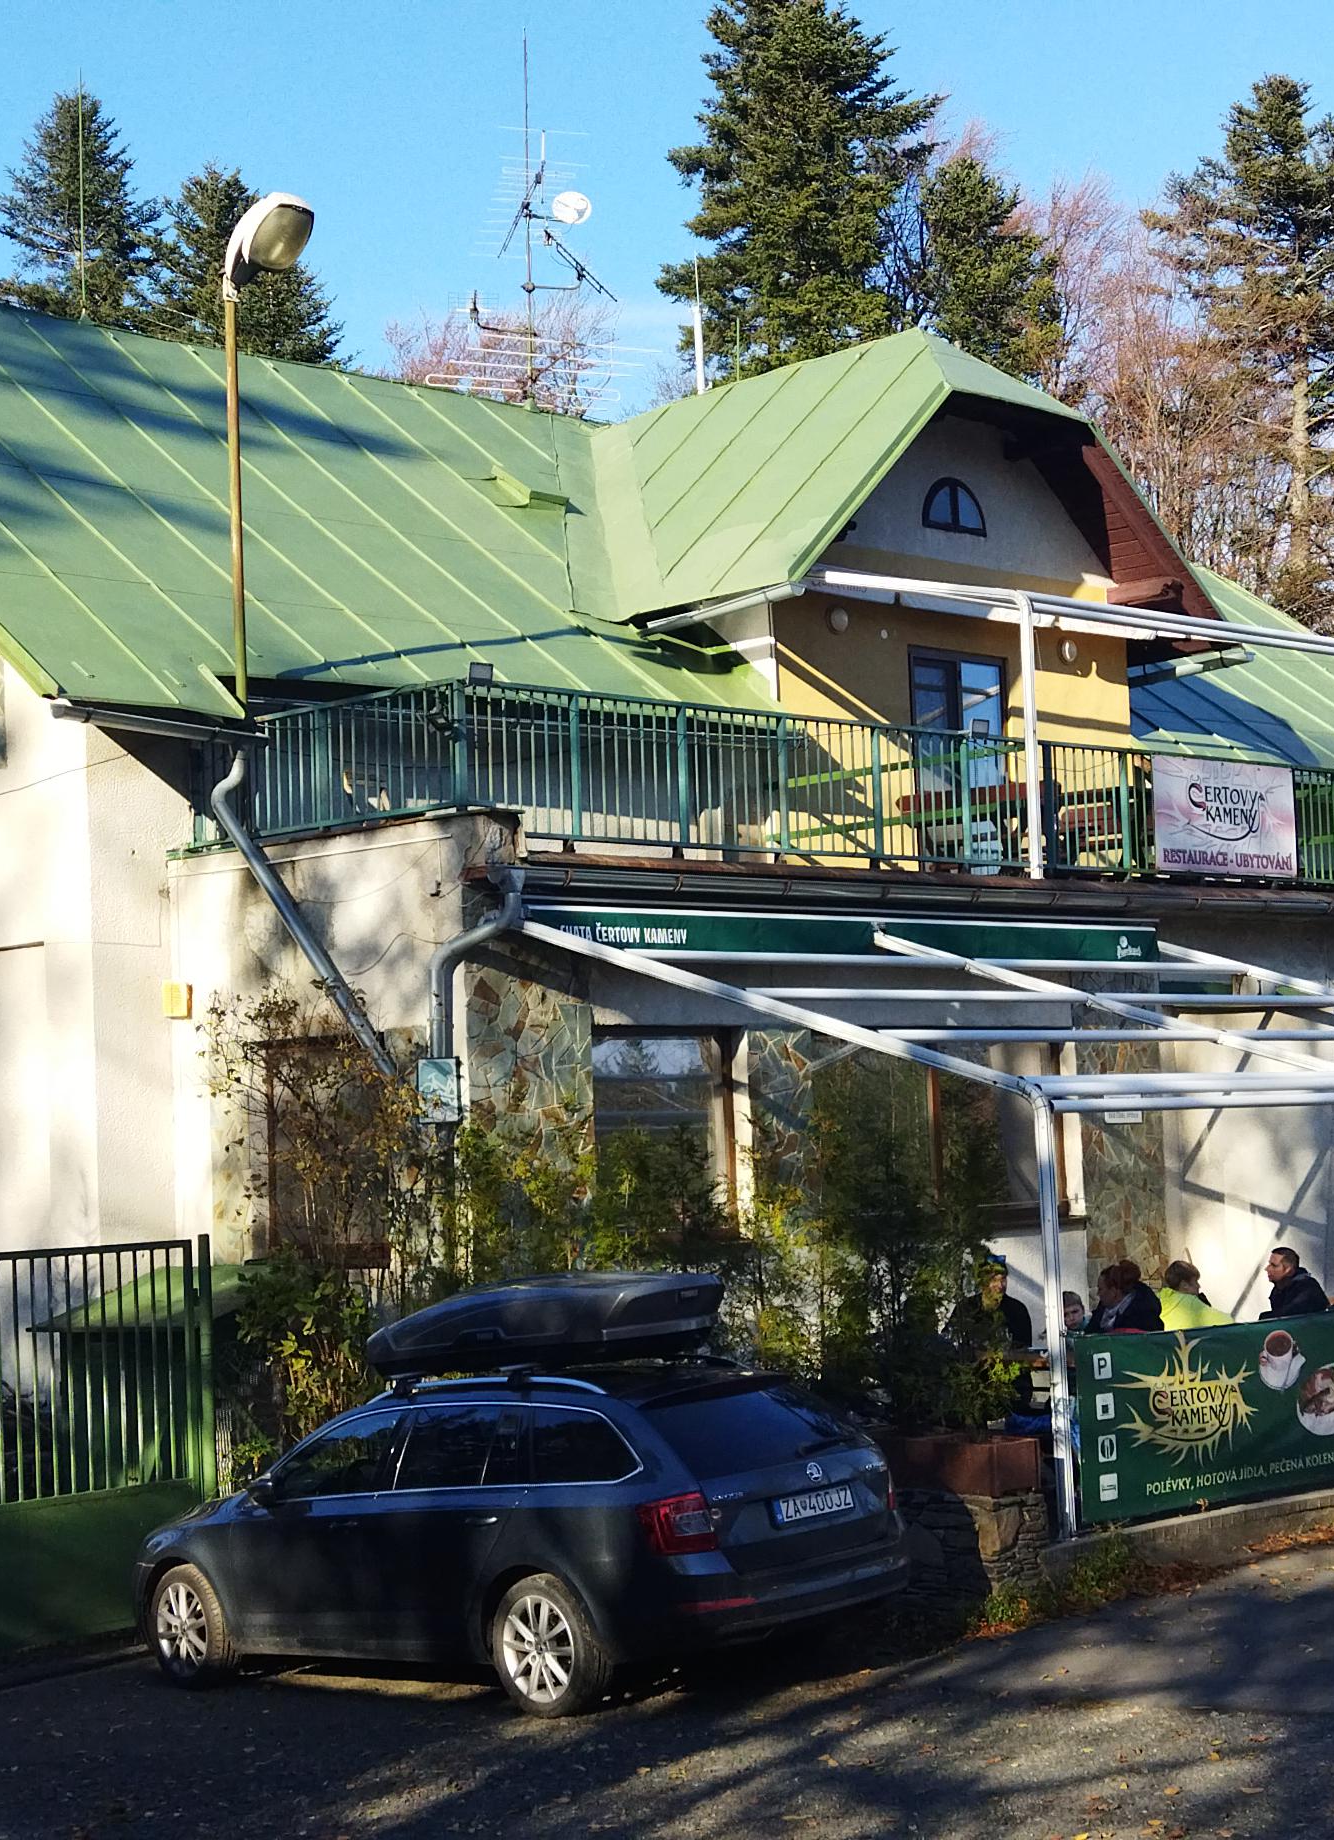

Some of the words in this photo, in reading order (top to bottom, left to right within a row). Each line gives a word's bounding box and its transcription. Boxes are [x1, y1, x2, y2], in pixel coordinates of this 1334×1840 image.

[1205, 805, 1258, 827] KAMENY
[1162, 848, 1229, 867] RESTAURACE
[1234, 849, 1293, 871] UBYTOVÁNÍ
[595, 921, 641, 944] ČERTOVY
[643, 927, 687, 945] KAMENY
[1097, 1357, 1108, 1376] P
[1171, 1403, 1229, 1427] KAMENY
[1146, 1477, 1194, 1495] POLÉVKY,
[1196, 1469, 1238, 1488] HOTOVÁ
[1238, 1462, 1268, 1480] JÍDLA,
[1269, 1456, 1305, 1474] PEČENÁ
[781, 1499, 802, 1519] ZA
[808, 1489, 852, 1513] 400JZ
